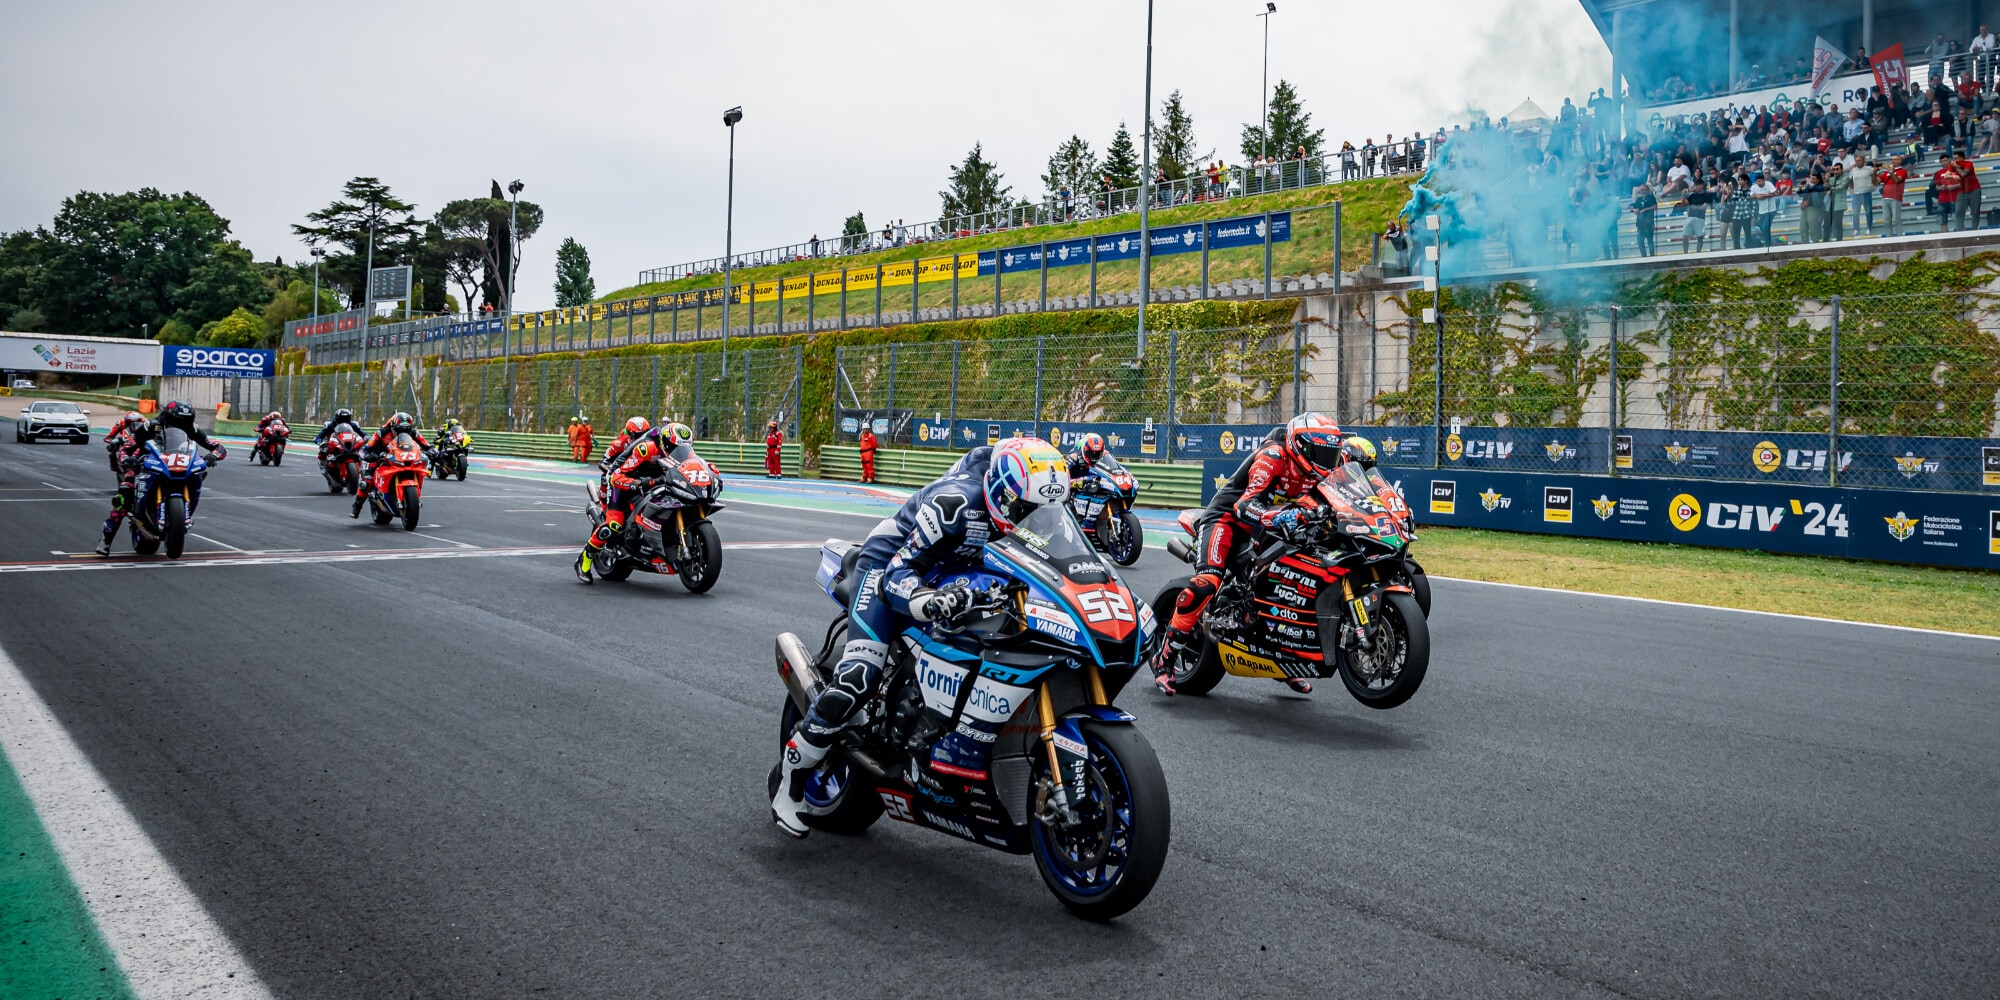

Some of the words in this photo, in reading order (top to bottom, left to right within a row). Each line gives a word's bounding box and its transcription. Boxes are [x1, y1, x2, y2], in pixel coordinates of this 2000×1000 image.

[1798, 92, 1831, 108] BC
[1217, 225, 1250, 238] federmoto.it
[816, 277, 843, 287] DUNLO
[854, 271, 885, 282] DUNLP
[895, 266, 928, 277] DUNOP
[940, 260, 976, 272] DULOP
[176, 349, 264, 368] sparco
[1062, 431, 1083, 446] CI
[1237, 436, 1264, 451] CI
[1465, 440, 1514, 459] CIV
[166, 453, 190, 466] 13
[1785, 449, 1854, 472] CIV
[1924, 464, 1939, 473] TV
[683, 469, 710, 484] 76
[1434, 487, 1451, 496] CIV
[1548, 494, 1568, 504] CIV
[1500, 500, 1511, 508] TV
[1620, 503, 1649, 511] Motociclistica
[1706, 502, 1787, 532] CIV
[1789, 499, 1849, 538] '24
[1923, 515, 1960, 523] Federazione
[1923, 522, 1962, 531] Motociclistica
[1923, 528, 1945, 536] Italiana
[651, 562, 669, 573] 76
[1076, 589, 1135, 623] 52
[1280, 608, 1298, 620] dto
[1036, 618, 1077, 642] YAMAHA
[1237, 655, 1276, 674] BARDAHL
[934, 761, 954, 773] Santander
[1074, 760, 1086, 800] DUNLOP
[880, 792, 915, 822] 52
[922, 809, 975, 840] YAMAHA
